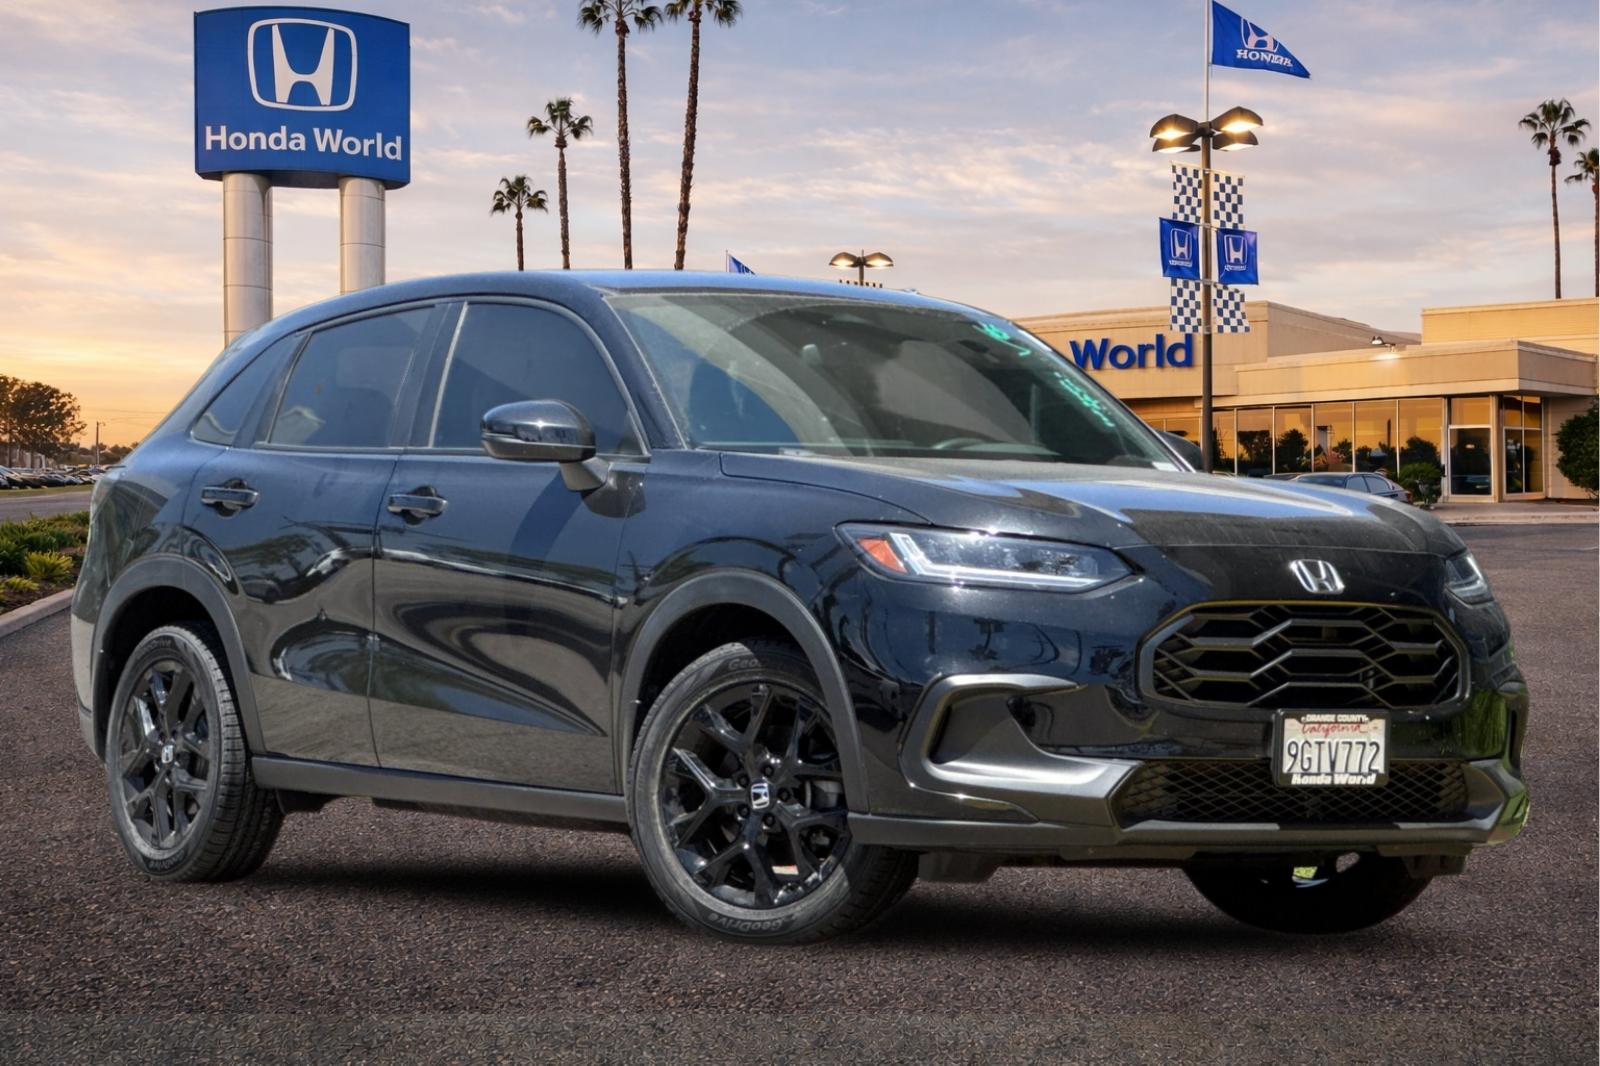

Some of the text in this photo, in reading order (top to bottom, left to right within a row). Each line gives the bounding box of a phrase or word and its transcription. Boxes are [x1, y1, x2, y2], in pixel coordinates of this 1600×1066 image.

[205, 125, 402, 161] Honda World
[1069, 333, 1193, 370] World
[1287, 741, 1380, 773] 9GTV772
[1291, 773, 1376, 785] Honda World
[708, 913, 783, 932] GeoDrive
